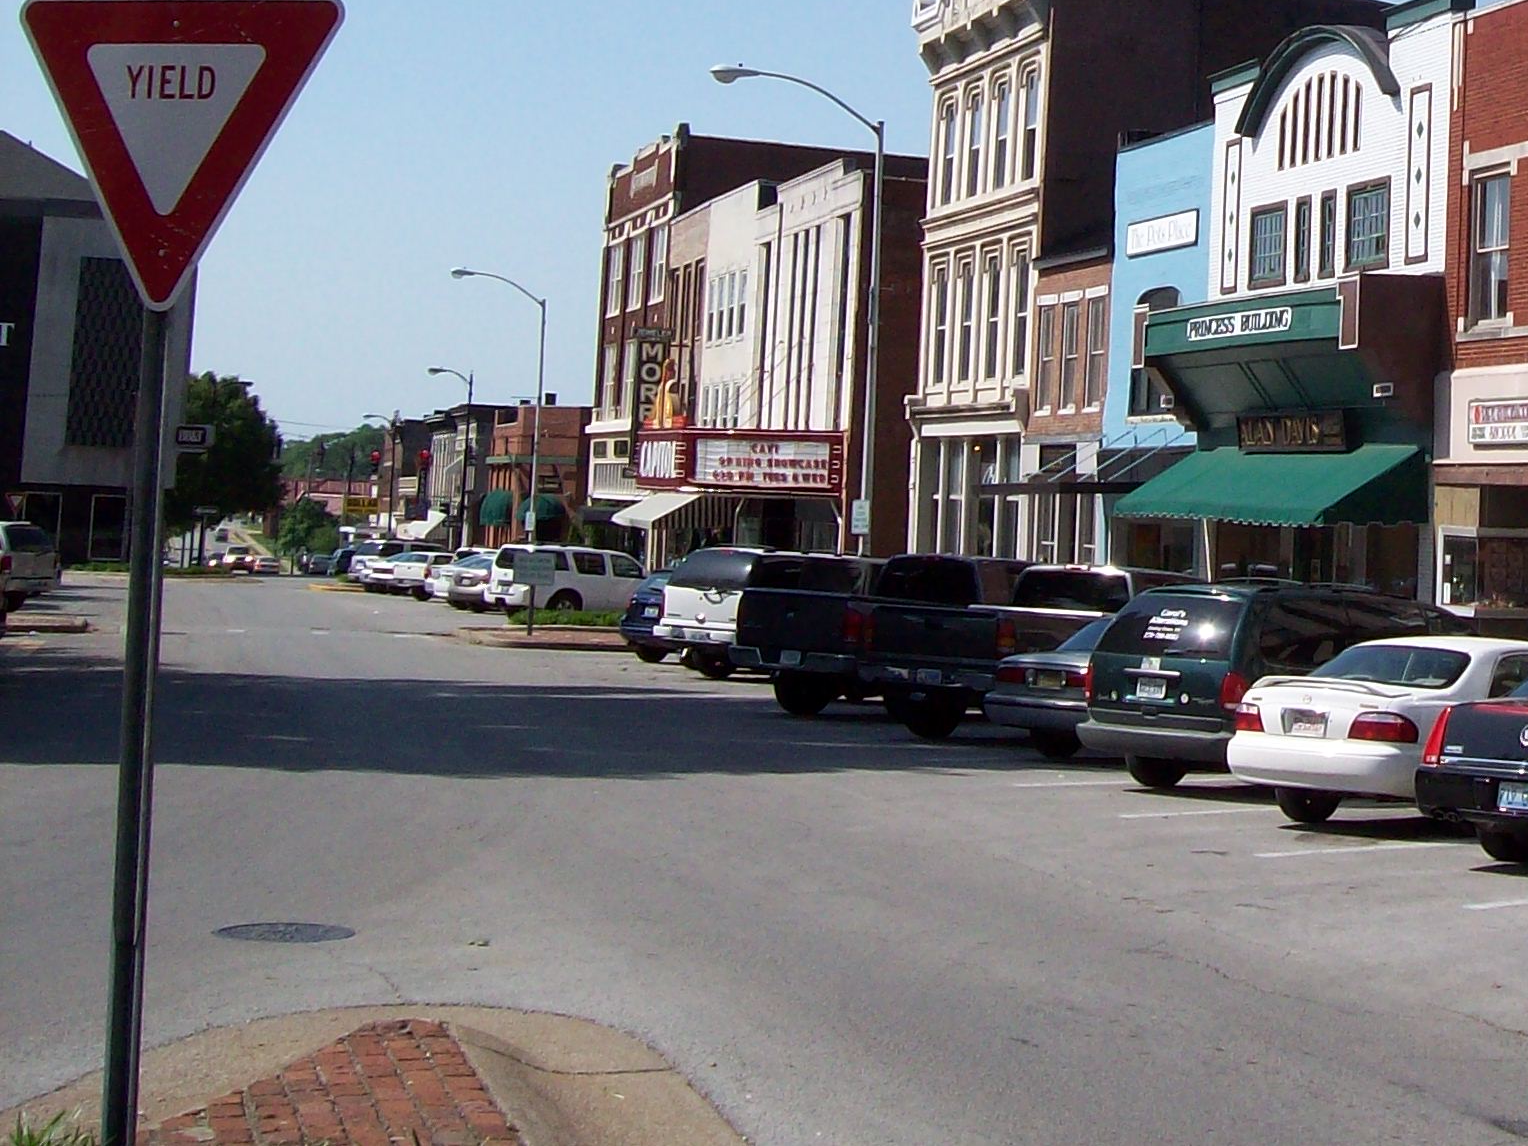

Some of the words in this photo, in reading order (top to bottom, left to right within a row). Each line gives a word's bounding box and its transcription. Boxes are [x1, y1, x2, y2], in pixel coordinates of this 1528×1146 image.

[126, 64, 217, 100] YIELD
[1189, 316, 1236, 338] PRINCESS
[1240, 309, 1289, 332] BUILDING
